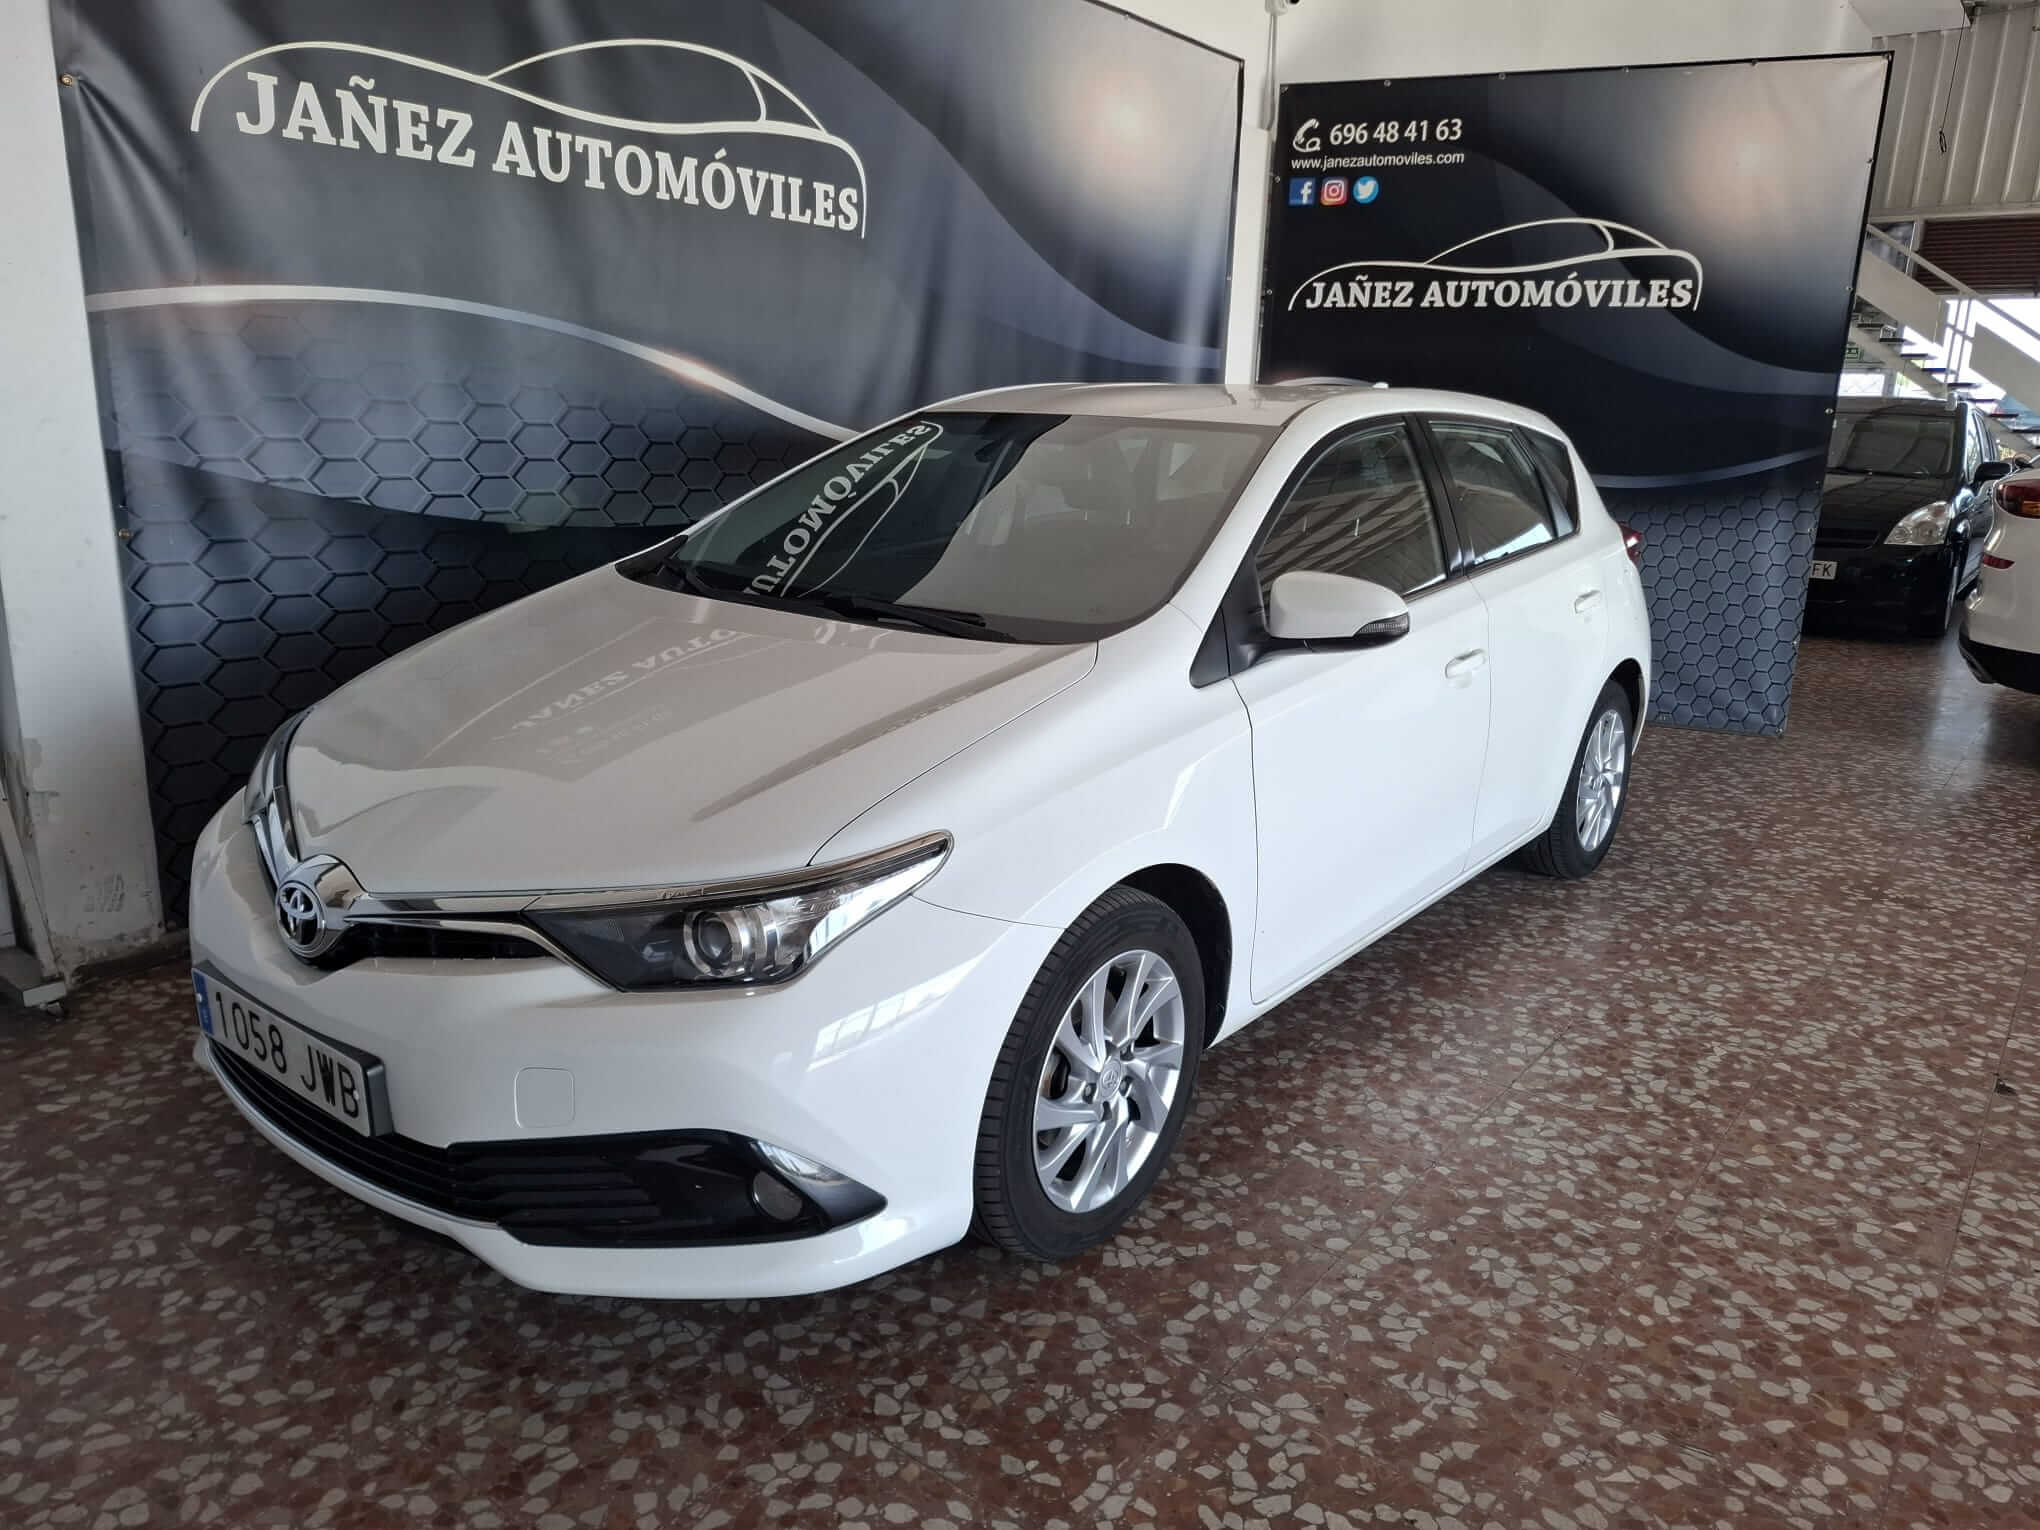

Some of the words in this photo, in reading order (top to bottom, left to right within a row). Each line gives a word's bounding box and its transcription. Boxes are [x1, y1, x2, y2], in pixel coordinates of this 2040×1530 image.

[1329, 123, 1368, 145] 696
[1372, 121, 1400, 142] 48
[1404, 119, 1429, 141] 41
[1435, 118, 1463, 141] 63
[236, 71, 476, 168] JAÑEZ
[492, 120, 859, 232] AUTOMÓVILES
[1291, 151, 1465, 171] www.janezautomoviles.com
[1305, 275, 1415, 308] JAÑEZ
[1420, 271, 1693, 308] AUTOMÓVILES
[215, 991, 287, 1074] 1058
[301, 1045, 360, 1119] JWB
